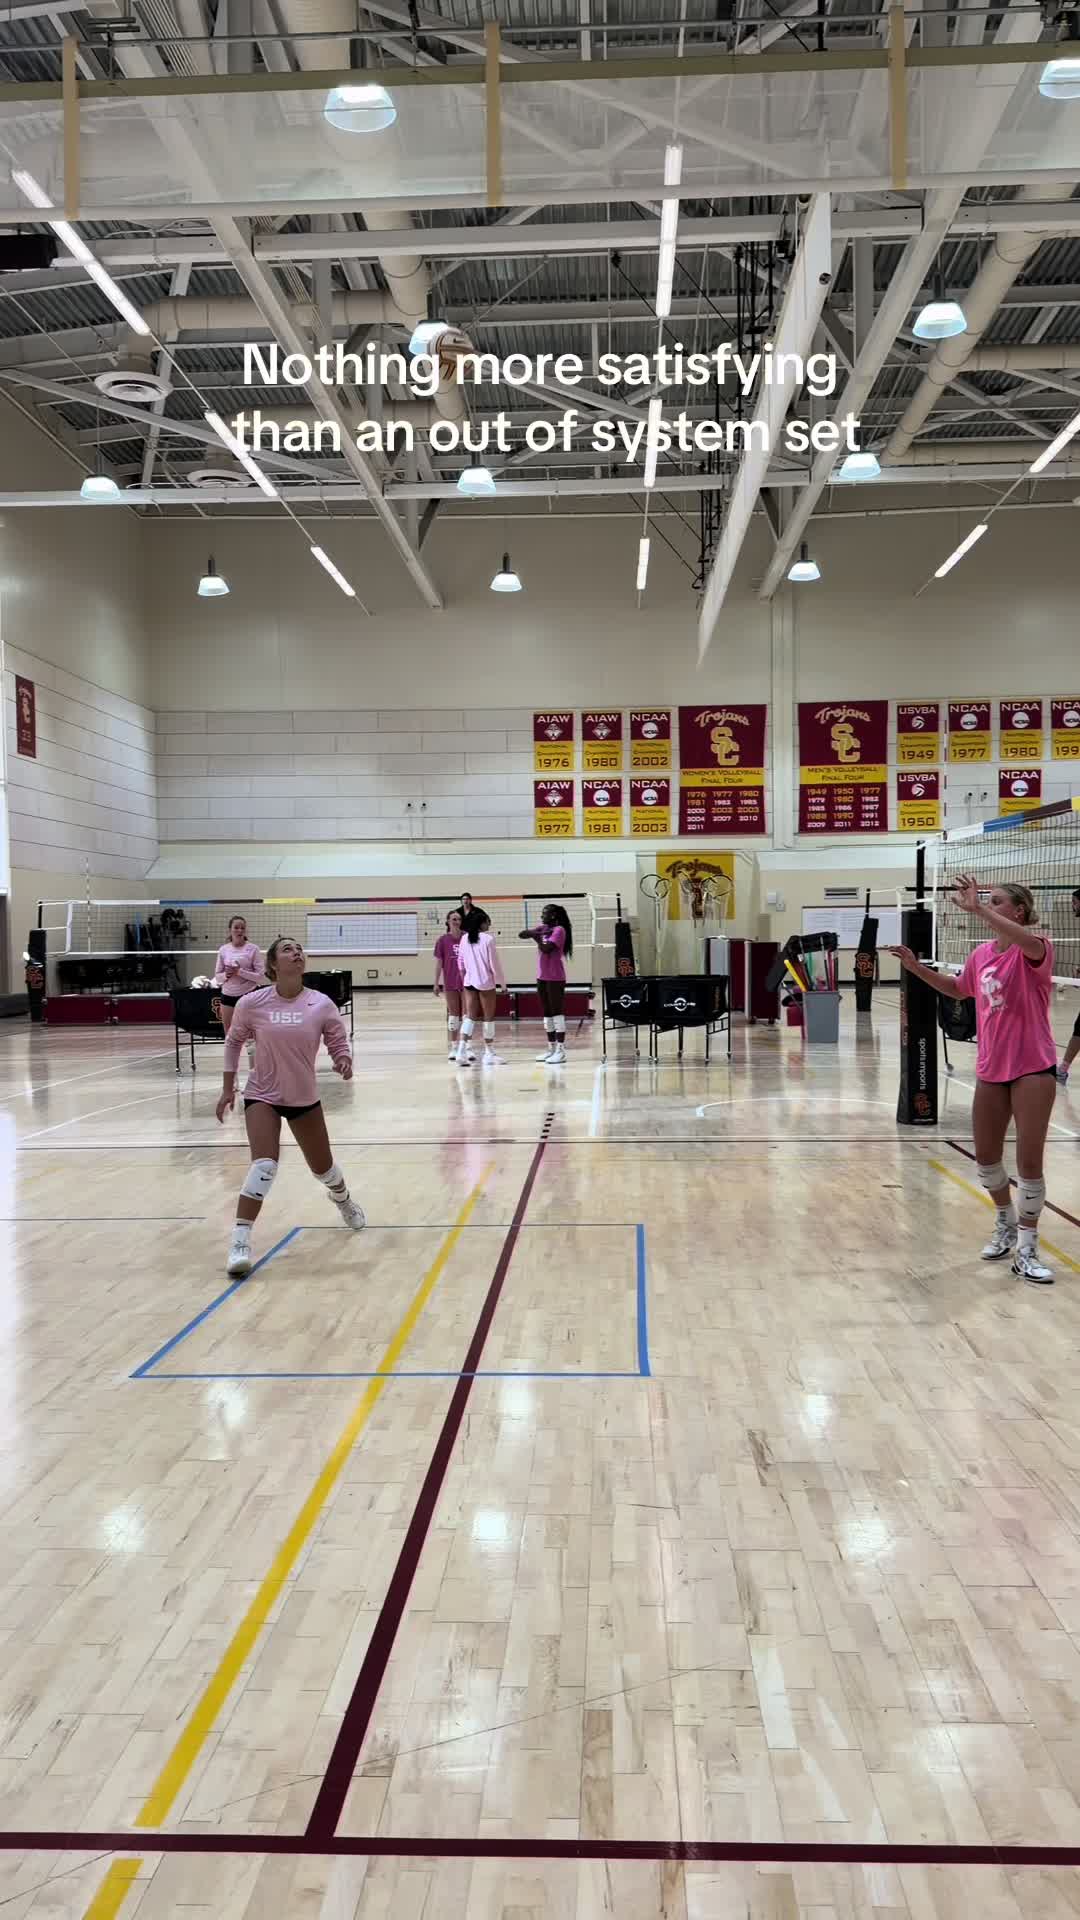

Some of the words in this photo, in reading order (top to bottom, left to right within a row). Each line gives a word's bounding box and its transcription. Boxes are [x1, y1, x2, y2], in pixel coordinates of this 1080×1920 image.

[899, 706, 937, 715] USVBA
[949, 704, 988, 713] NCAA
[1001, 702, 1040, 711] NCAA
[537, 715, 570, 723] AIAW
[585, 714, 618, 722] AIAW
[631, 713, 668, 721] NCAA
[694, 708, 751, 728] Trojans
[814, 705, 872, 724] Trojans
[902, 750, 934, 760] 1949
[952, 748, 986, 758] 1977
[1003, 747, 1038, 758] 1980
[538, 758, 570, 768] 1976
[586, 757, 618, 767] 1980
[633, 757, 668, 766] 2002
[899, 774, 937, 782] USVBA
[1000, 771, 1039, 779] NCAA
[537, 781, 570, 789] AIAW
[583, 781, 620, 789] NCAA
[631, 780, 668, 788] NCAA
[901, 817, 935, 826] 1950
[538, 824, 570, 833] 1977
[588, 824, 617, 833] 1981
[633, 823, 668, 832] 2003
[269, 1011, 303, 1024] USC
[917, 1061, 928, 1090] imports
